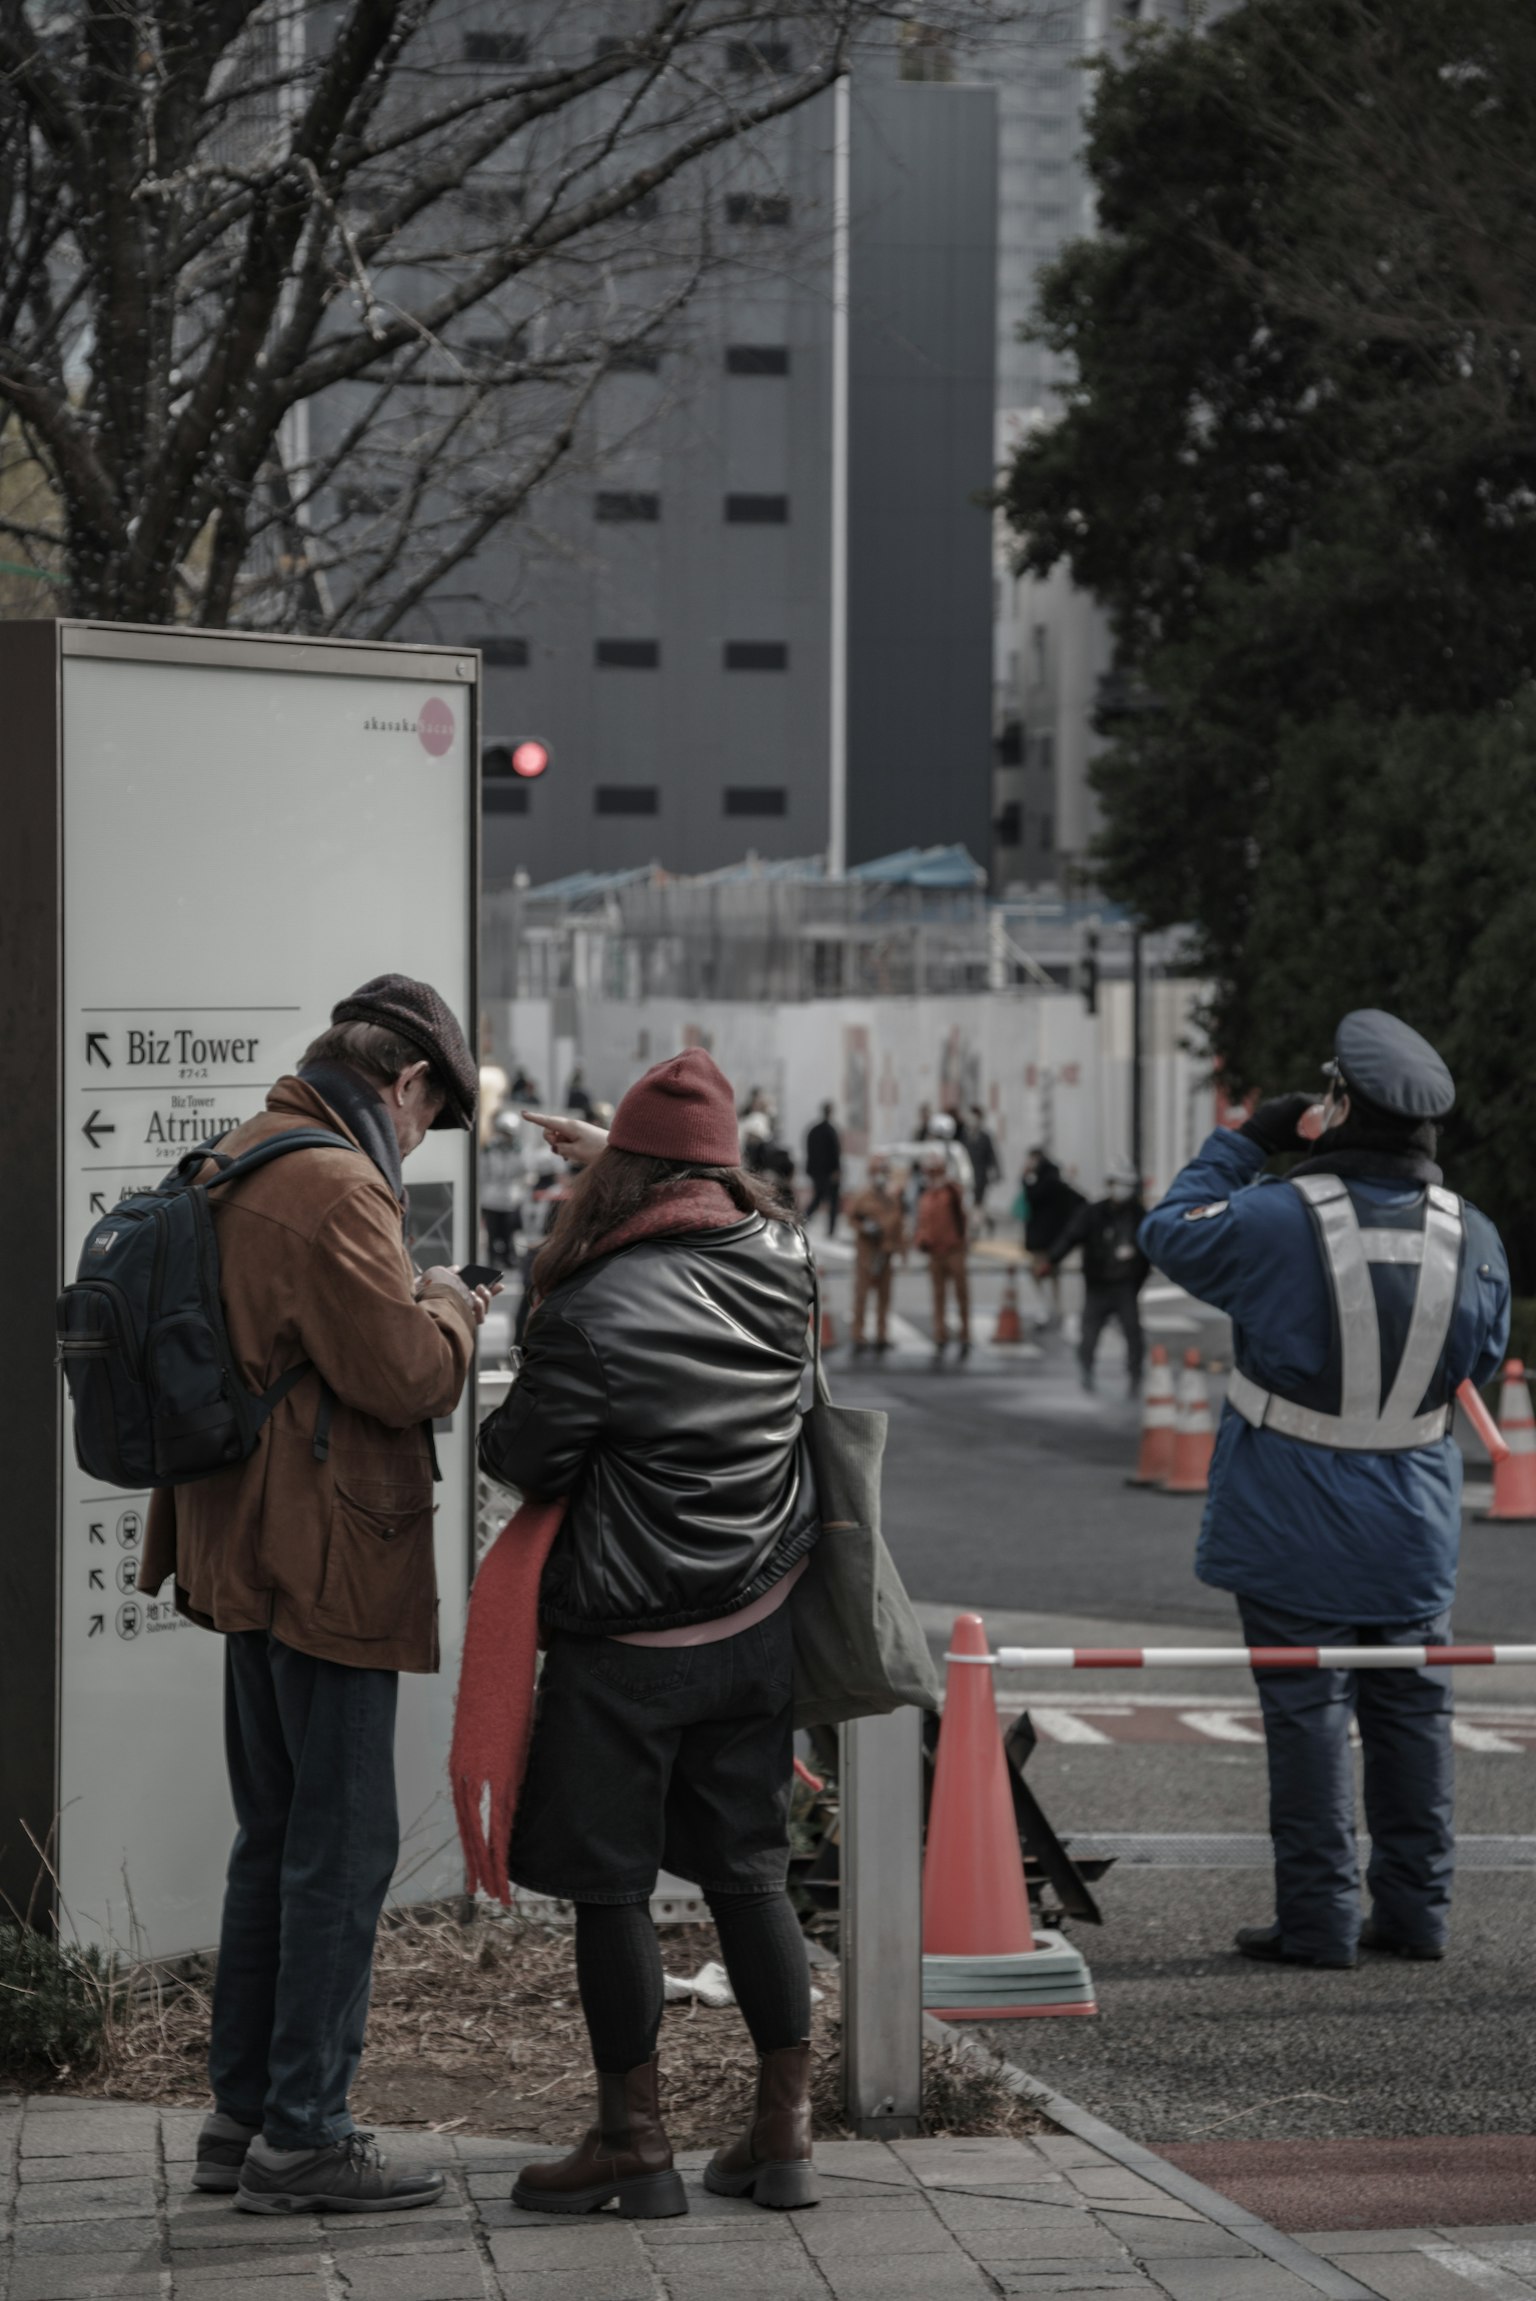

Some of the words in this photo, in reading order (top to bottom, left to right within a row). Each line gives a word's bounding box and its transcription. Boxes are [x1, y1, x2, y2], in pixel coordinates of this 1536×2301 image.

[363, 716, 416, 732] akasaka
[126, 1030, 171, 1066] Biz
[174, 1029, 259, 1064] Tower
[178, 1068, 208, 1079] オフィス
[171, 1095, 186, 1108] Biz
[187, 1094, 215, 1108] Tower
[144, 1109, 241, 1144] Atrium
